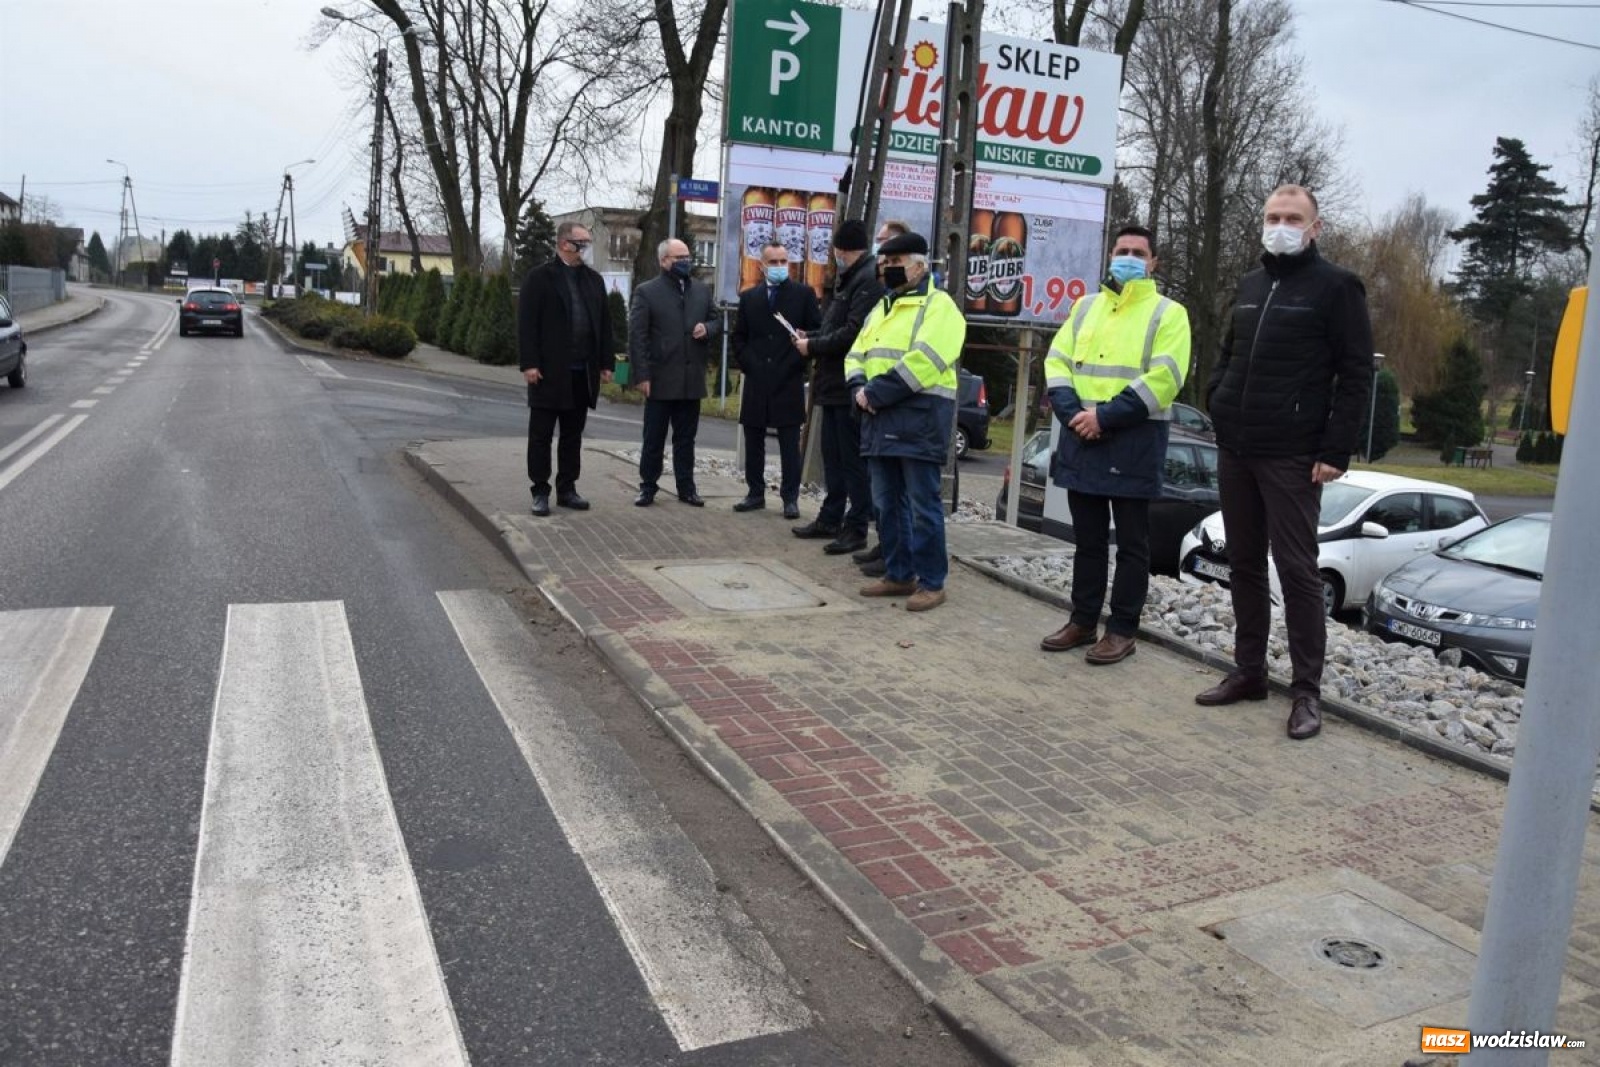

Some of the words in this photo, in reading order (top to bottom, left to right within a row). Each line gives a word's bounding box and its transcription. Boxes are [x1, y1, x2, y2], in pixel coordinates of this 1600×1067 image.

[769, 50, 801, 96] P
[997, 44, 1081, 81] SKLEP
[742, 115, 821, 141] KANTOR
[984, 145, 1036, 165] NISKIE
[1044, 153, 1086, 173] CENY
[882, 190, 933, 200] NIEBEZPIECZN
[1023, 275, 1086, 316] 1,99
[1411, 626, 1440, 643] 60645
